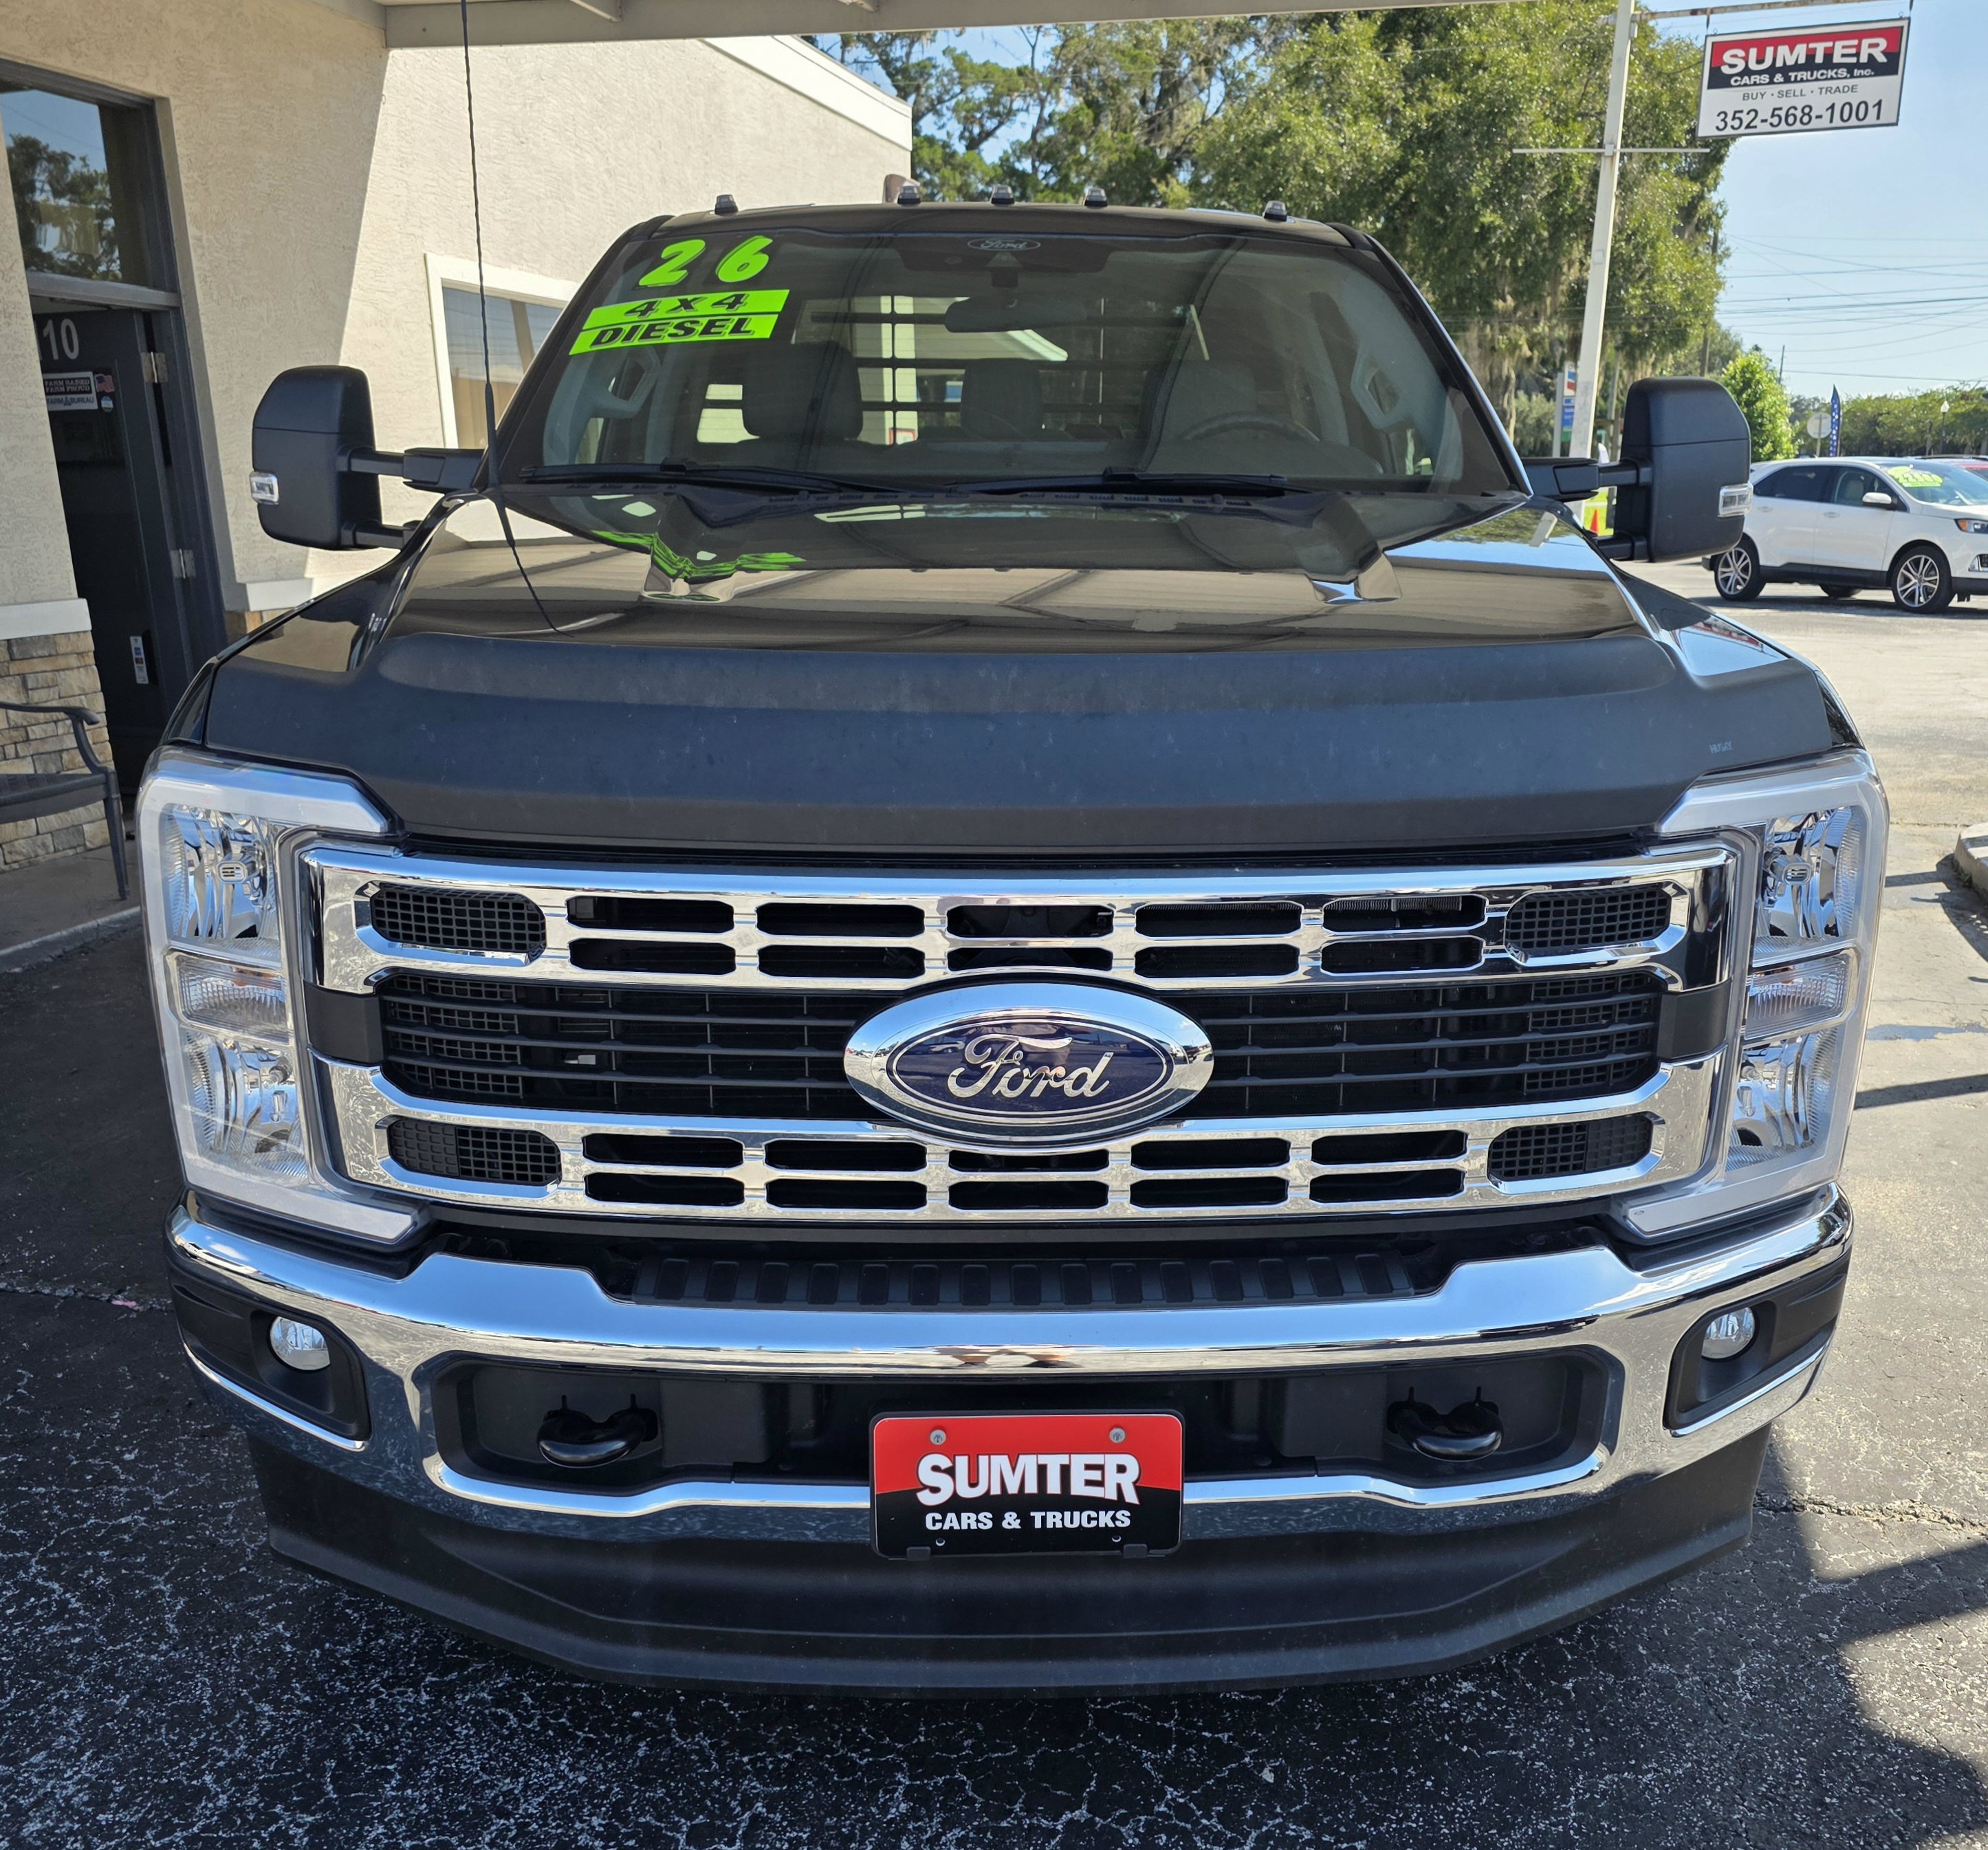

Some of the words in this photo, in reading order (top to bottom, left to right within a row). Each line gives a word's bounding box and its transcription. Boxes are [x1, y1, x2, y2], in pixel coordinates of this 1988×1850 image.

[1721, 37, 1888, 74] SUMTER
[1730, 74, 1770, 86] CARS
[1773, 73, 1784, 82] &
[1853, 68, 1875, 76] Inc.
[1743, 91, 1767, 101] BUY
[1777, 89, 1806, 98] SELL
[1818, 84, 1859, 95] TRADE
[1715, 98, 1883, 131] 352-568-1001
[980, 239, 1028, 249] Ford
[34, 318, 80, 360] 10
[589, 317, 756, 348] DIESEL
[947, 1033, 1115, 1098] Ford
[917, 1453, 1140, 1506] SUMTER
[925, 1512, 993, 1530] CARS
[1001, 1511, 1022, 1530] &
[1030, 1510, 1131, 1530] TRUCKS
